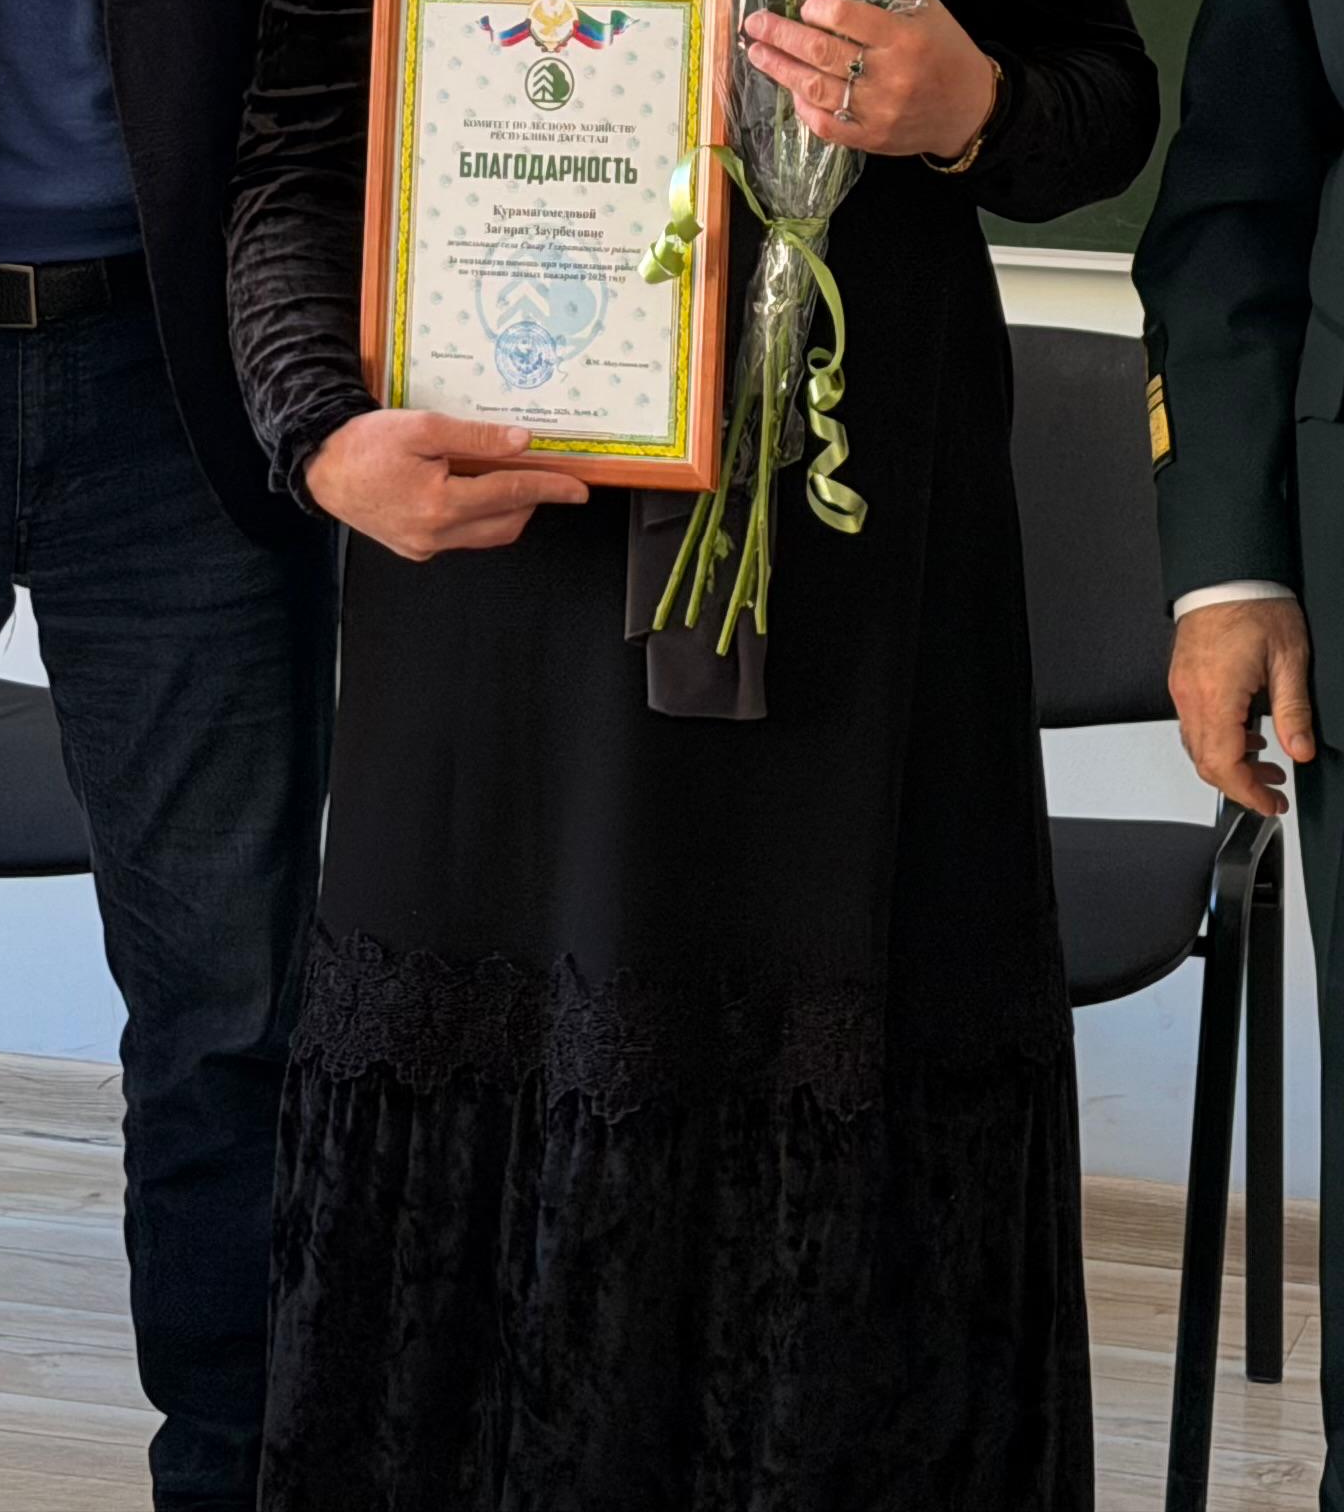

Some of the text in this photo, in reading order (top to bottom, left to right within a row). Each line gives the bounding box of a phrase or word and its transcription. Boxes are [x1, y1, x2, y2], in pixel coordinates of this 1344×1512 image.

[490, 131, 608, 143] РЕСПУБЛИКИ ДАГЕСТАН
[459, 152, 638, 185] БЛАГОДАРНОСТЬ
[493, 204, 597, 221] Курамагомедовой
